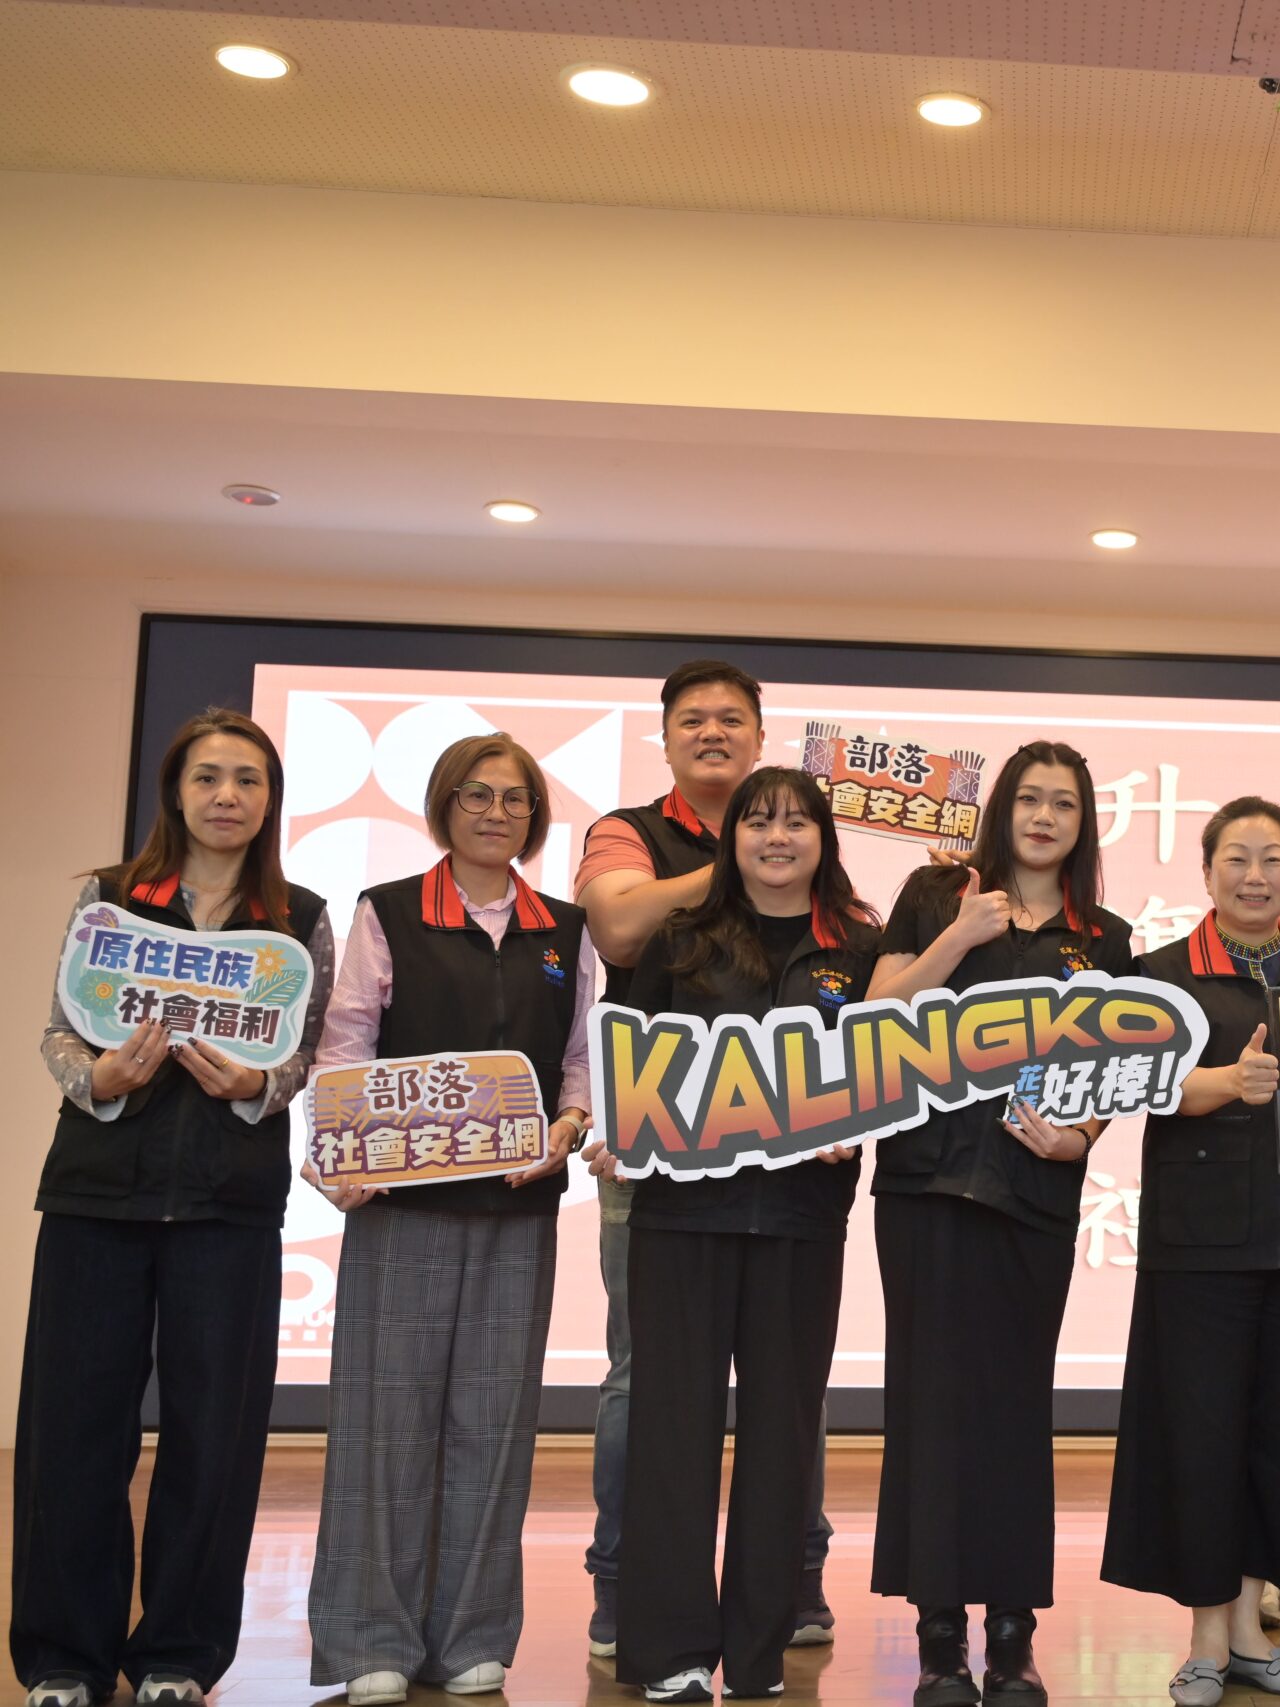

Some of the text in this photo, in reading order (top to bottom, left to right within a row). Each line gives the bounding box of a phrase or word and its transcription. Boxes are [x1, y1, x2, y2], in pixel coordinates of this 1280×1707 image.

[847, 735, 931, 784] 部落
[89, 929, 255, 989] 原住民族
[119, 987, 281, 1045] 社會福利
[367, 1061, 474, 1111] 部落
[610, 996, 1176, 1153] KALINGKO
[1009, 1064, 1044, 1122] 花
[1038, 1051, 1176, 1115] 好棒!
[317, 1116, 541, 1174] 社會安全網
